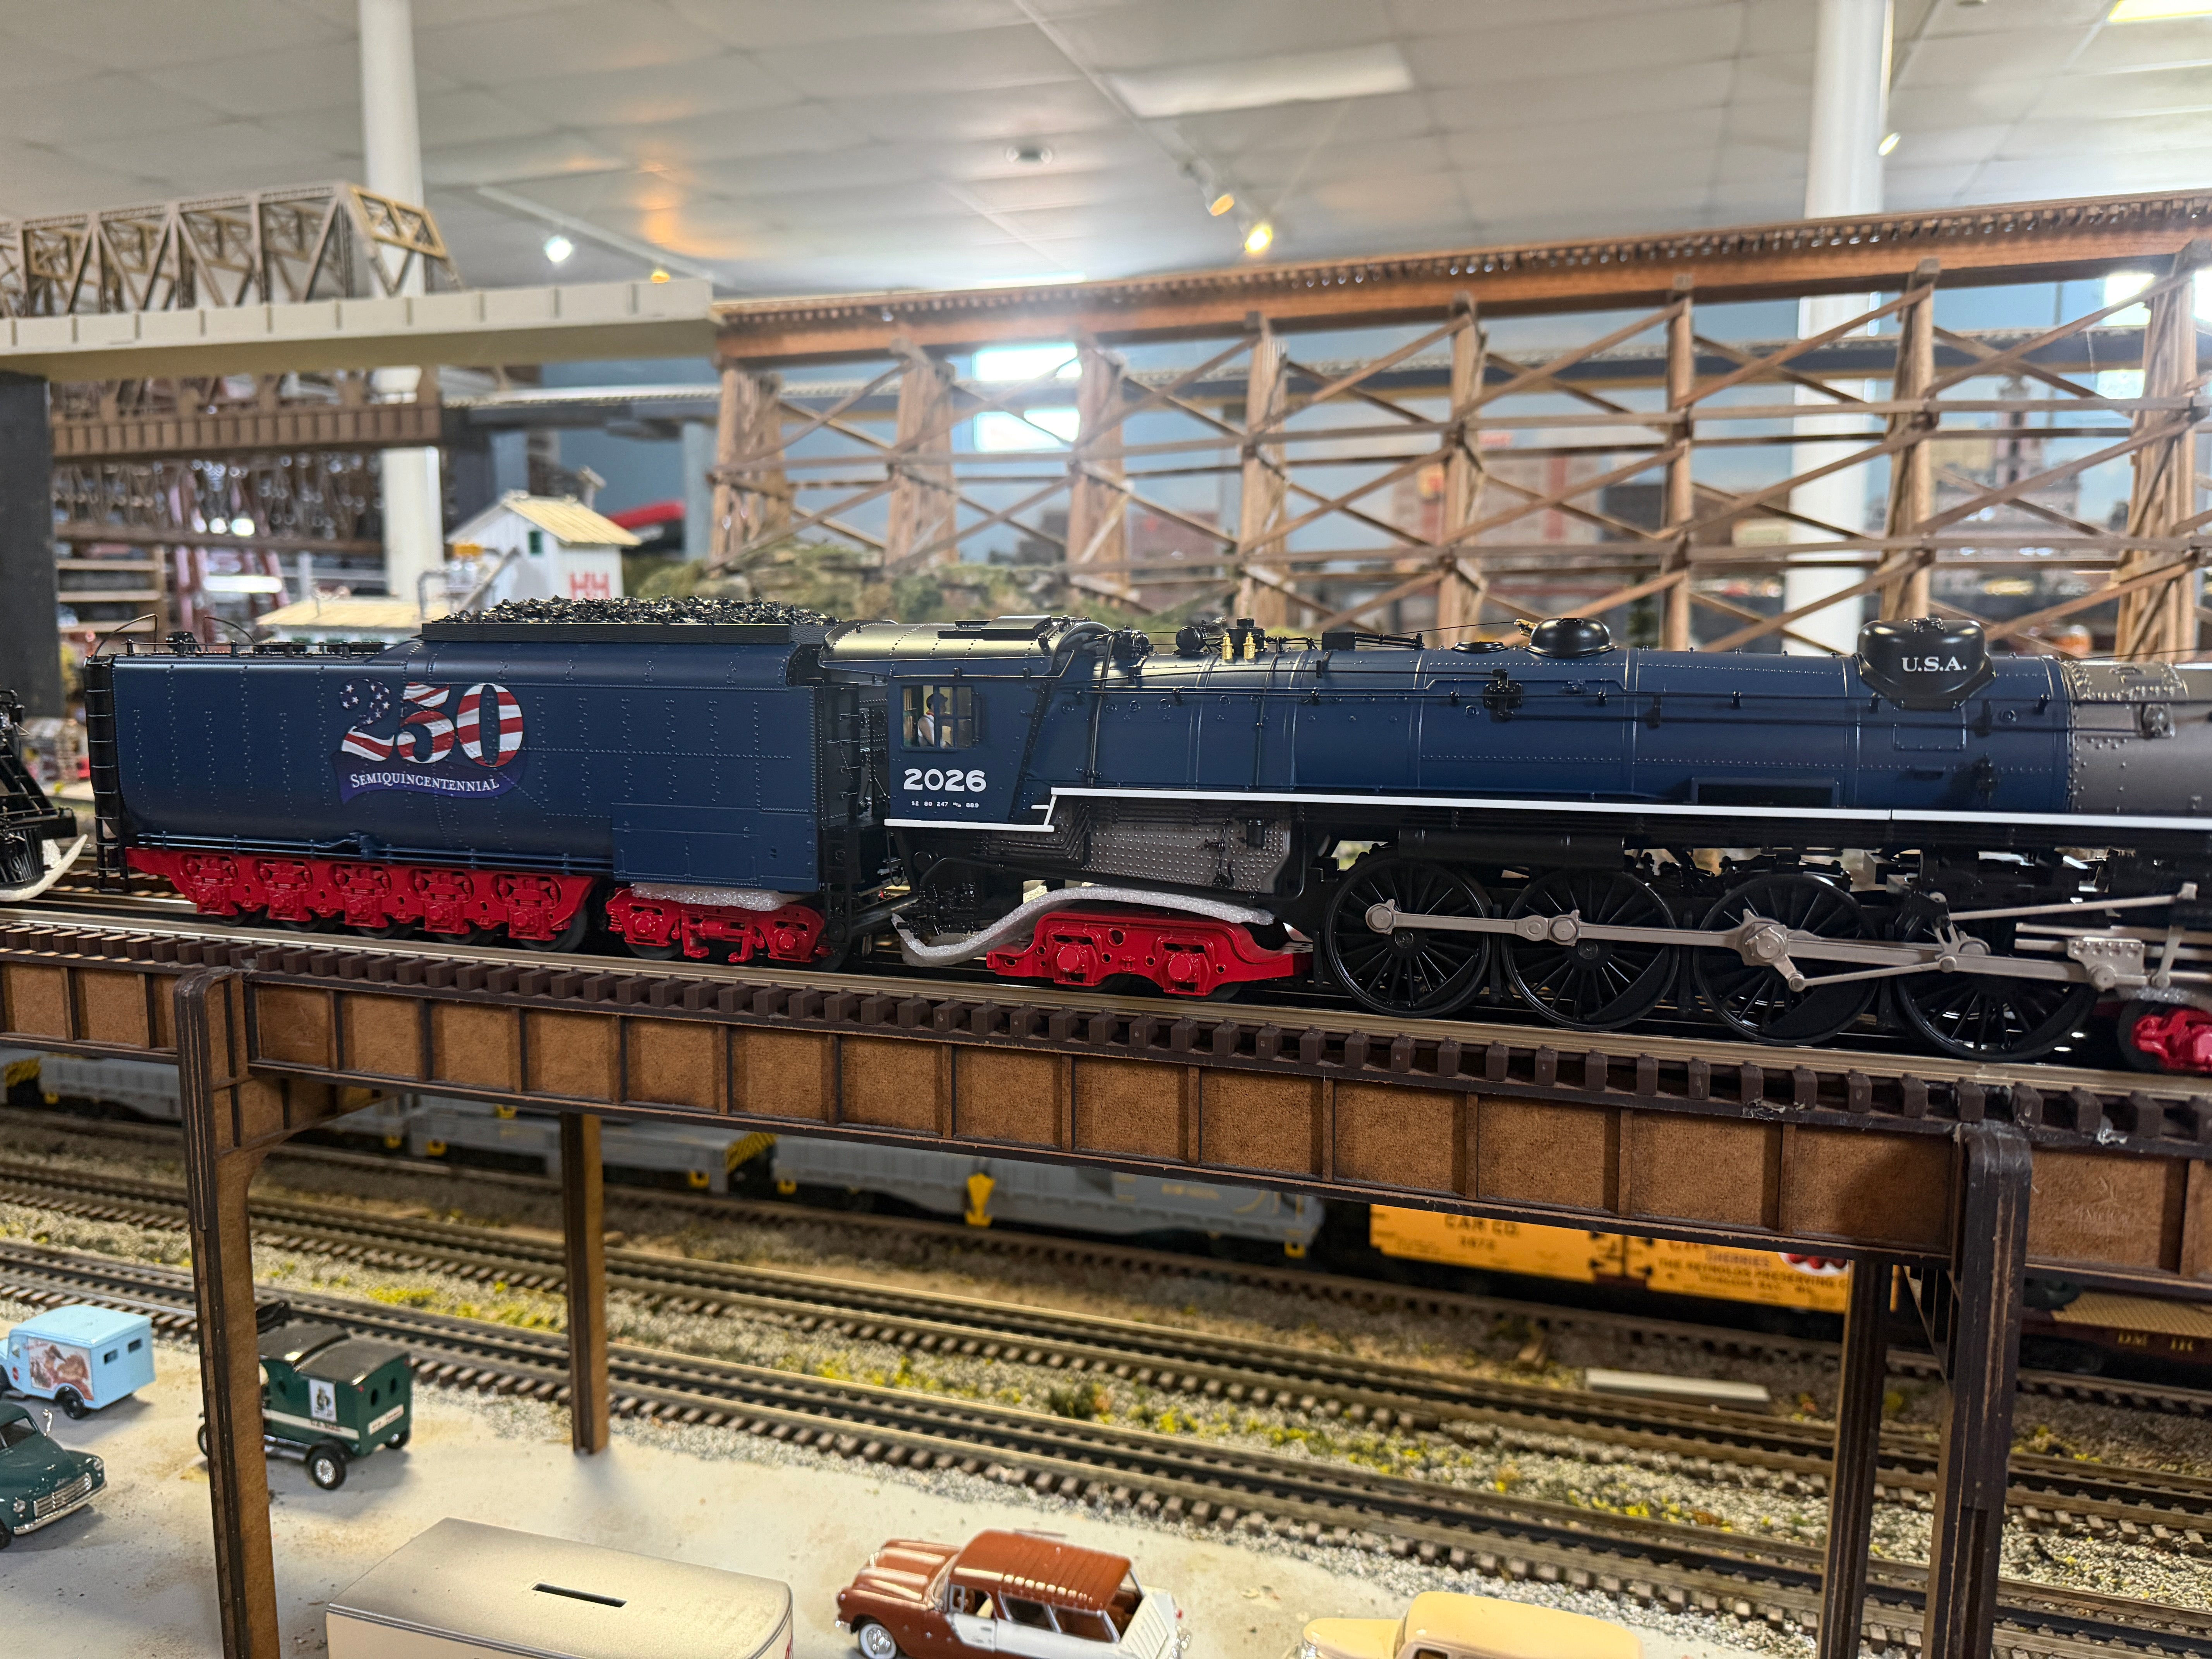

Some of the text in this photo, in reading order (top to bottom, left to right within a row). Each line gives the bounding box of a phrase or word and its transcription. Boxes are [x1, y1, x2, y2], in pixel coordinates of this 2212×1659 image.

[1902, 656, 1967, 672] U.S.A.
[340, 678, 523, 767] 250
[350, 772, 500, 792] SEMIQUINCENTENNIAL
[903, 768, 987, 792] 2026
